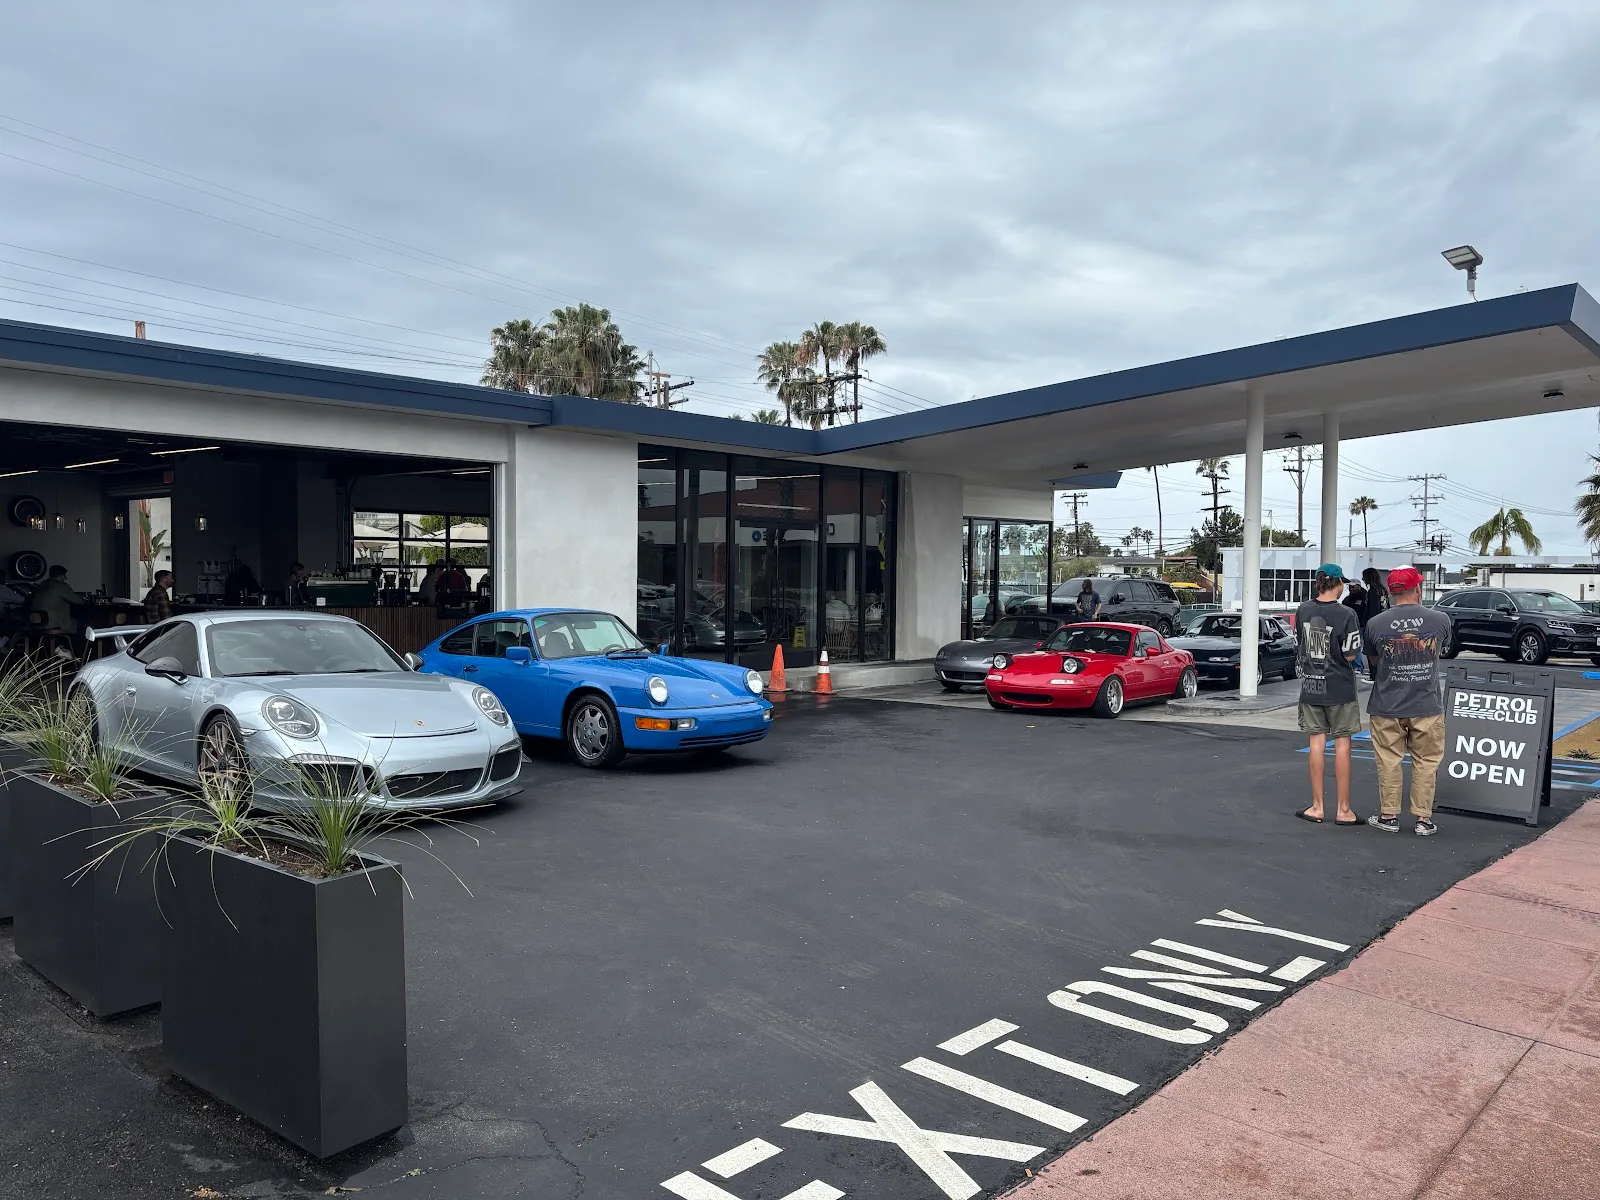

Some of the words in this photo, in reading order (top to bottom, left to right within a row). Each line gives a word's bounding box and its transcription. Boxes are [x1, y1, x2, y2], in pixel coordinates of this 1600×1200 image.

[1390, 618, 1424, 630] OTW
[1454, 692, 1538, 714] PETROL
[1494, 710, 1537, 725] CLUB
[1455, 735, 1526, 760] NOW
[1448, 760, 1525, 787] OPEN
[1047, 909, 1350, 1045] ONLY
